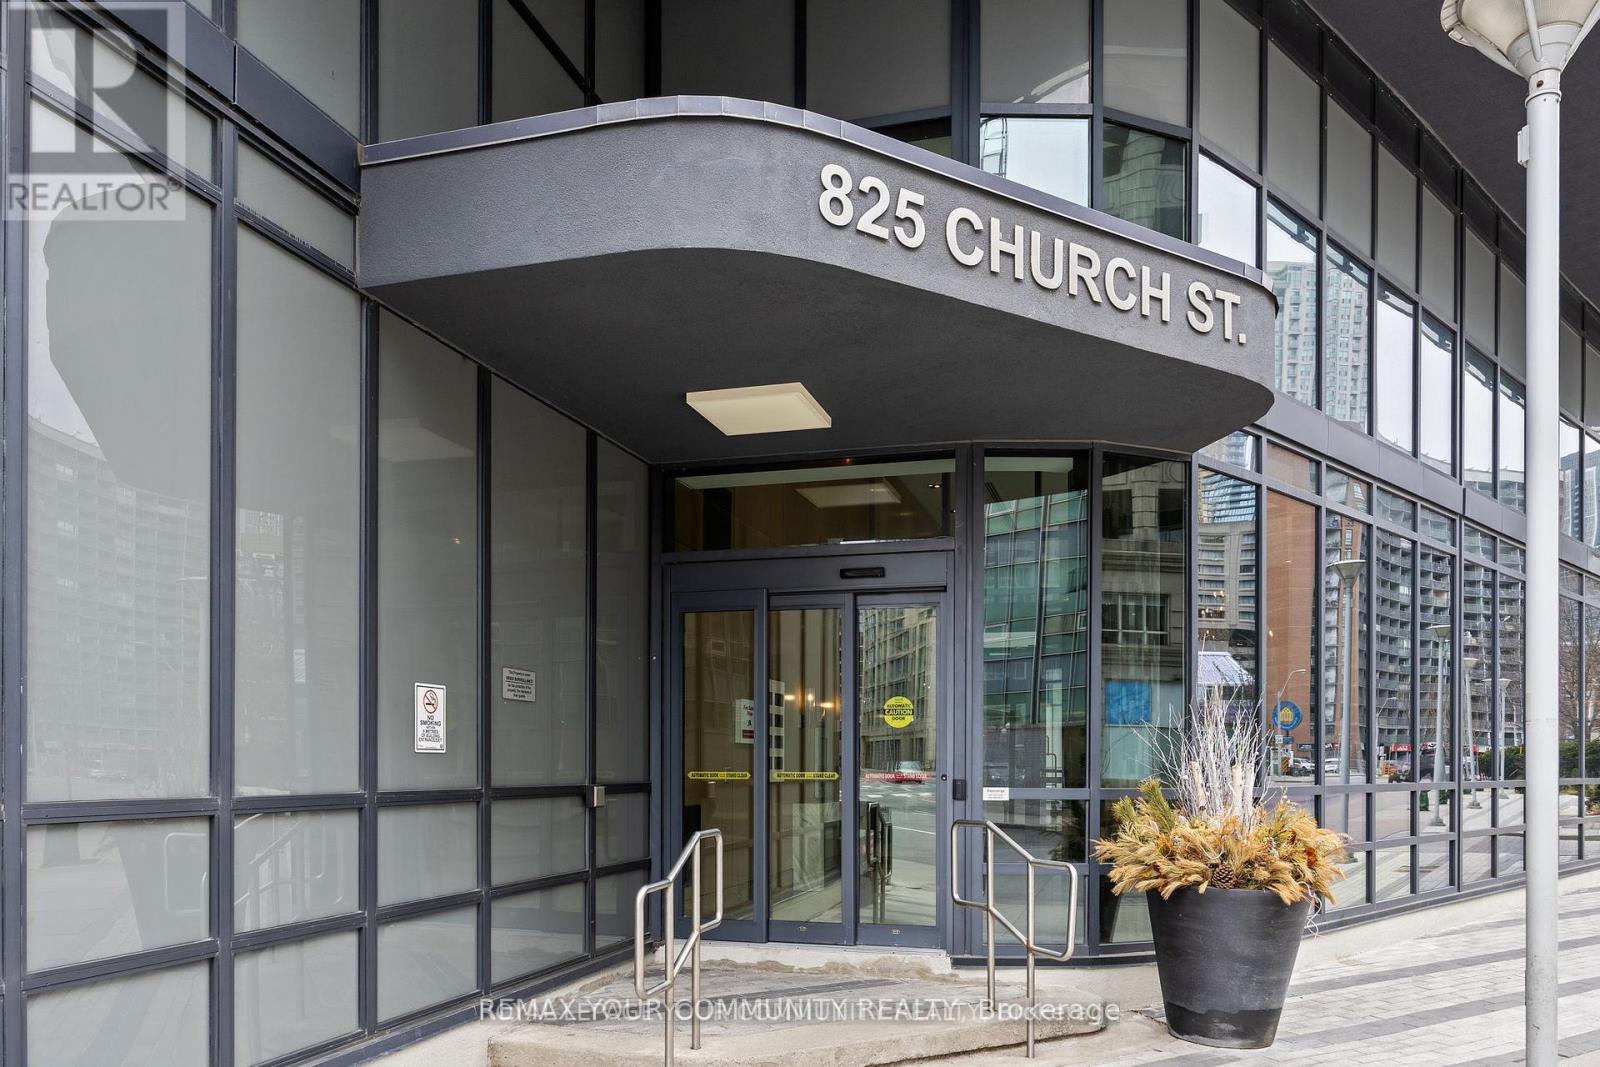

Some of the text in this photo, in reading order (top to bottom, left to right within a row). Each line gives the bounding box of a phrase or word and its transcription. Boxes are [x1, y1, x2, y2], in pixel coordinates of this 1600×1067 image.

[818, 163, 1247, 344] 825 CHURCH ST.
[420, 719, 442, 727] SMOKING
